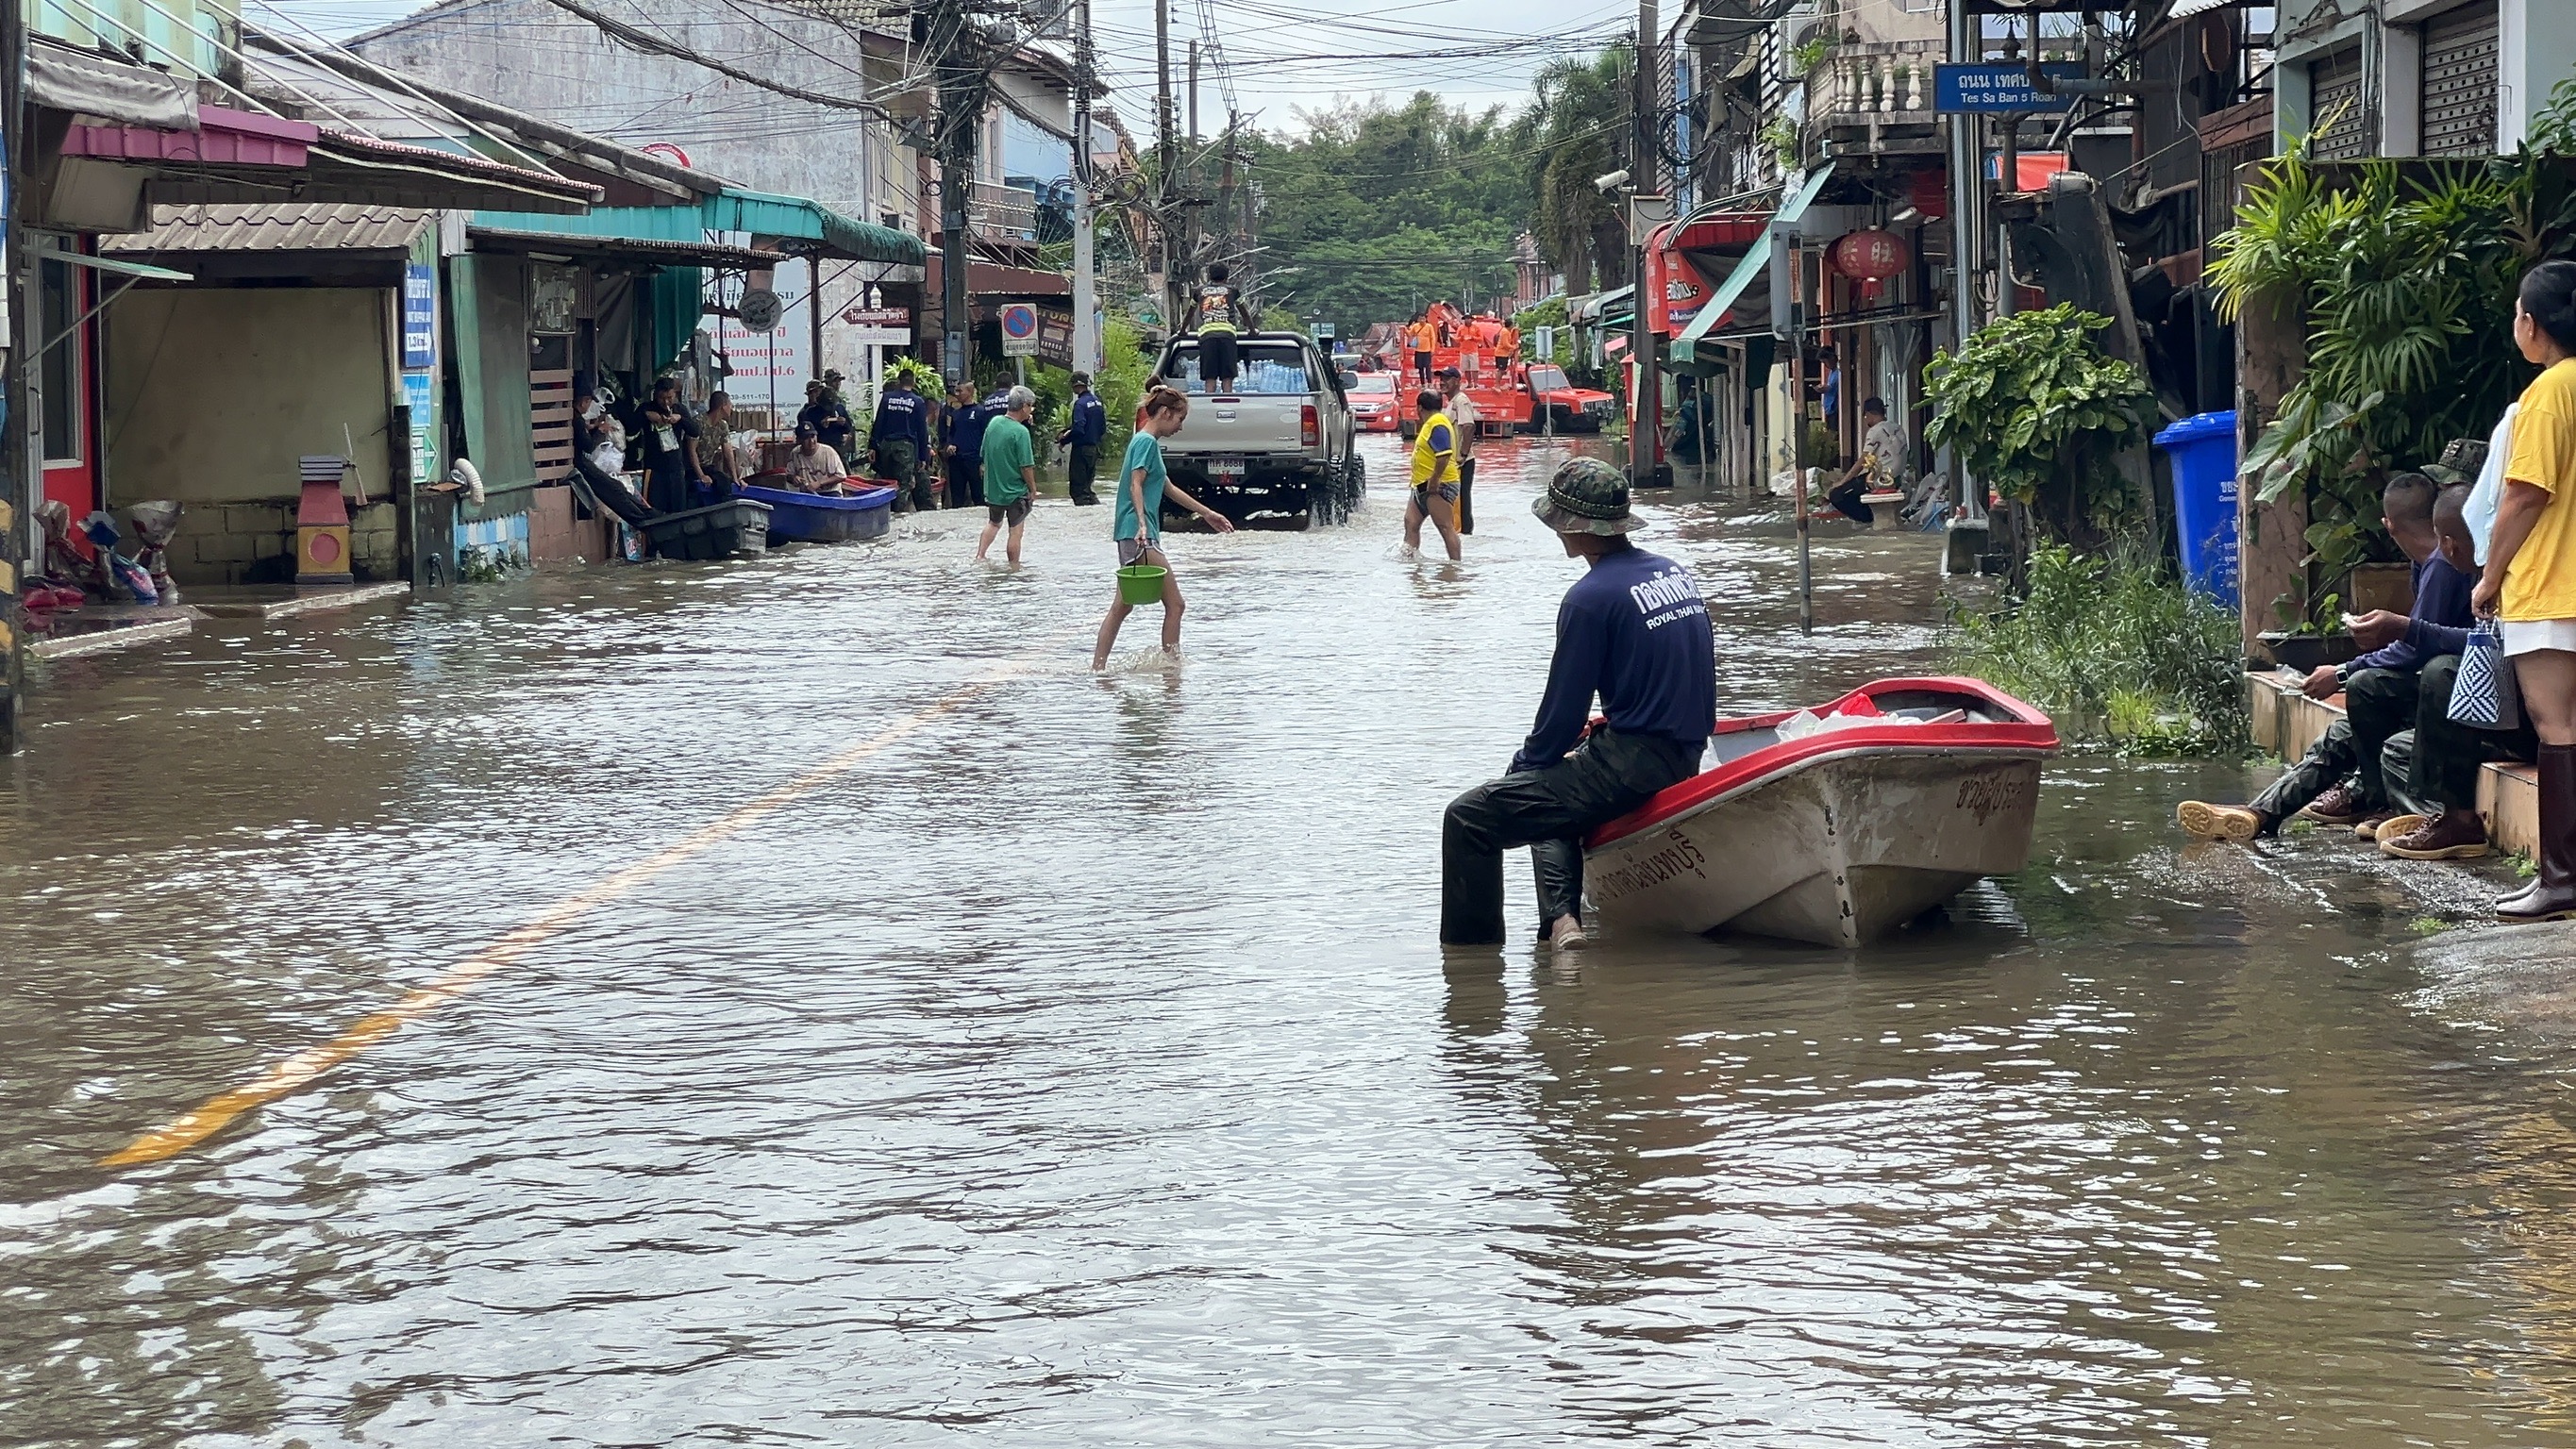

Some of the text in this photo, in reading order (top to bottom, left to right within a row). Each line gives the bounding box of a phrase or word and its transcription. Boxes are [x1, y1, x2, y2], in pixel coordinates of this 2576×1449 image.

[1958, 75, 1990, 89] ถนน
[1995, 74, 2047, 89] เทศบ
[1961, 92, 1979, 103] Tes
[1982, 92, 1995, 103] Sa
[1999, 92, 2017, 103] Ban
[2021, 93, 2028, 102] 5
[1646, 610, 1678, 630] ROYAL
[1675, 605, 1695, 619] THAI
